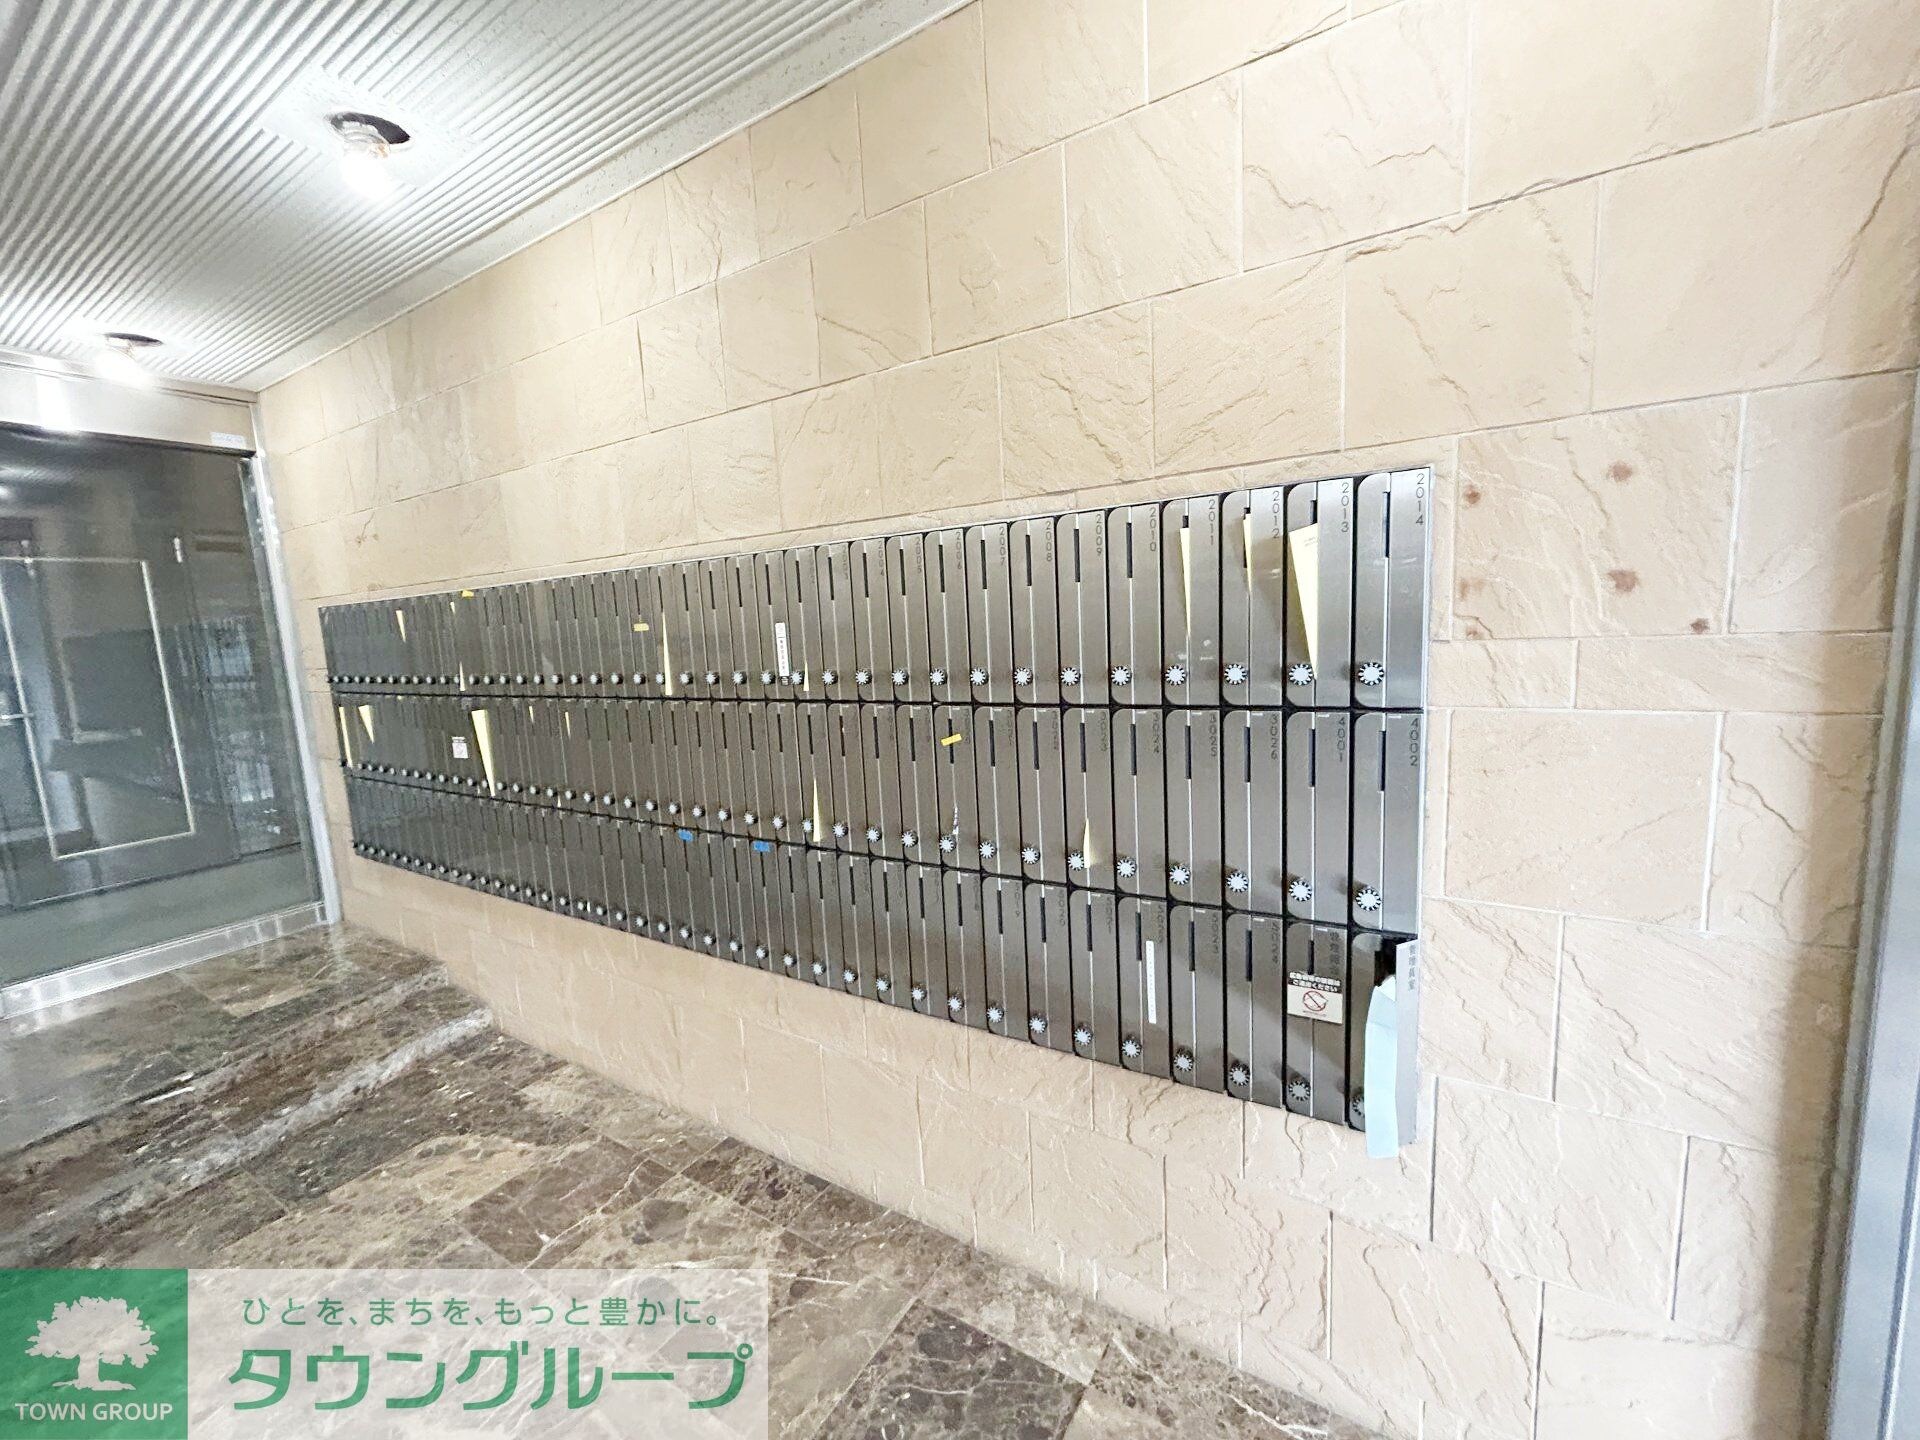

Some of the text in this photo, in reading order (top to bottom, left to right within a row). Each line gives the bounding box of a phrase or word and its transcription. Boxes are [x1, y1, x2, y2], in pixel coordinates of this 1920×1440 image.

[1208, 499, 1216, 546] 2011
[1272, 490, 1281, 539] 2012
[1340, 481, 1350, 533] 2013
[1415, 472, 1425, 526] 2014
[1095, 513, 1103, 557] 2009
[1149, 506, 1157, 552] 2010
[1208, 713, 1217, 758] 3025
[1269, 714, 1278, 760] 3026
[1336, 716, 1346, 763] 4001
[1409, 717, 1419, 767] 4002
